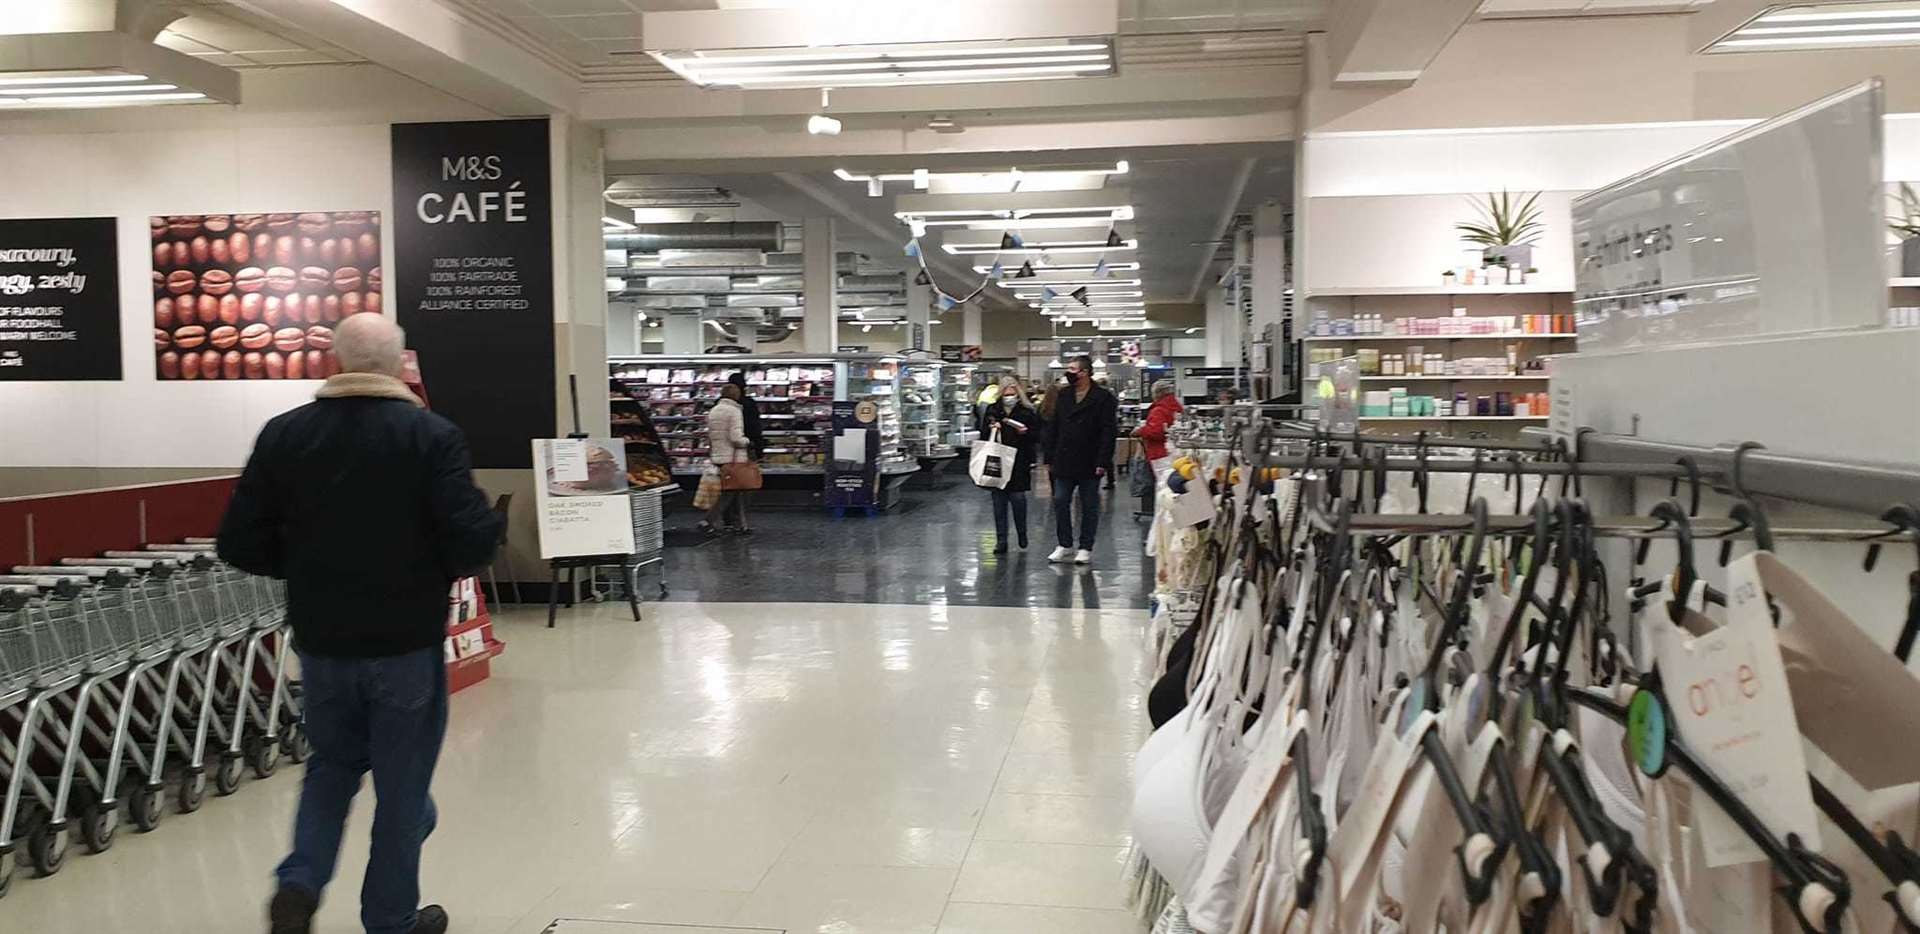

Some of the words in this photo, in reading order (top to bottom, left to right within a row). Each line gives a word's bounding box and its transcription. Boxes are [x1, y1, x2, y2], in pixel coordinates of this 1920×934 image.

[441, 155, 502, 181] M&S
[416, 180, 528, 224] CAFÉ
[433, 257, 460, 268] 100%
[462, 257, 515, 268] ORGANIC
[37, 271, 87, 294] zesty
[429, 272, 456, 282] 100%
[458, 271, 519, 282] FAIRTRADE
[425, 286, 453, 297] 100%
[454, 285, 522, 296] RAINFOREST
[11, 306, 64, 316] FLAVOURS
[418, 300, 473, 311] ALLIANCE
[474, 299, 529, 310] CERTIFIED
